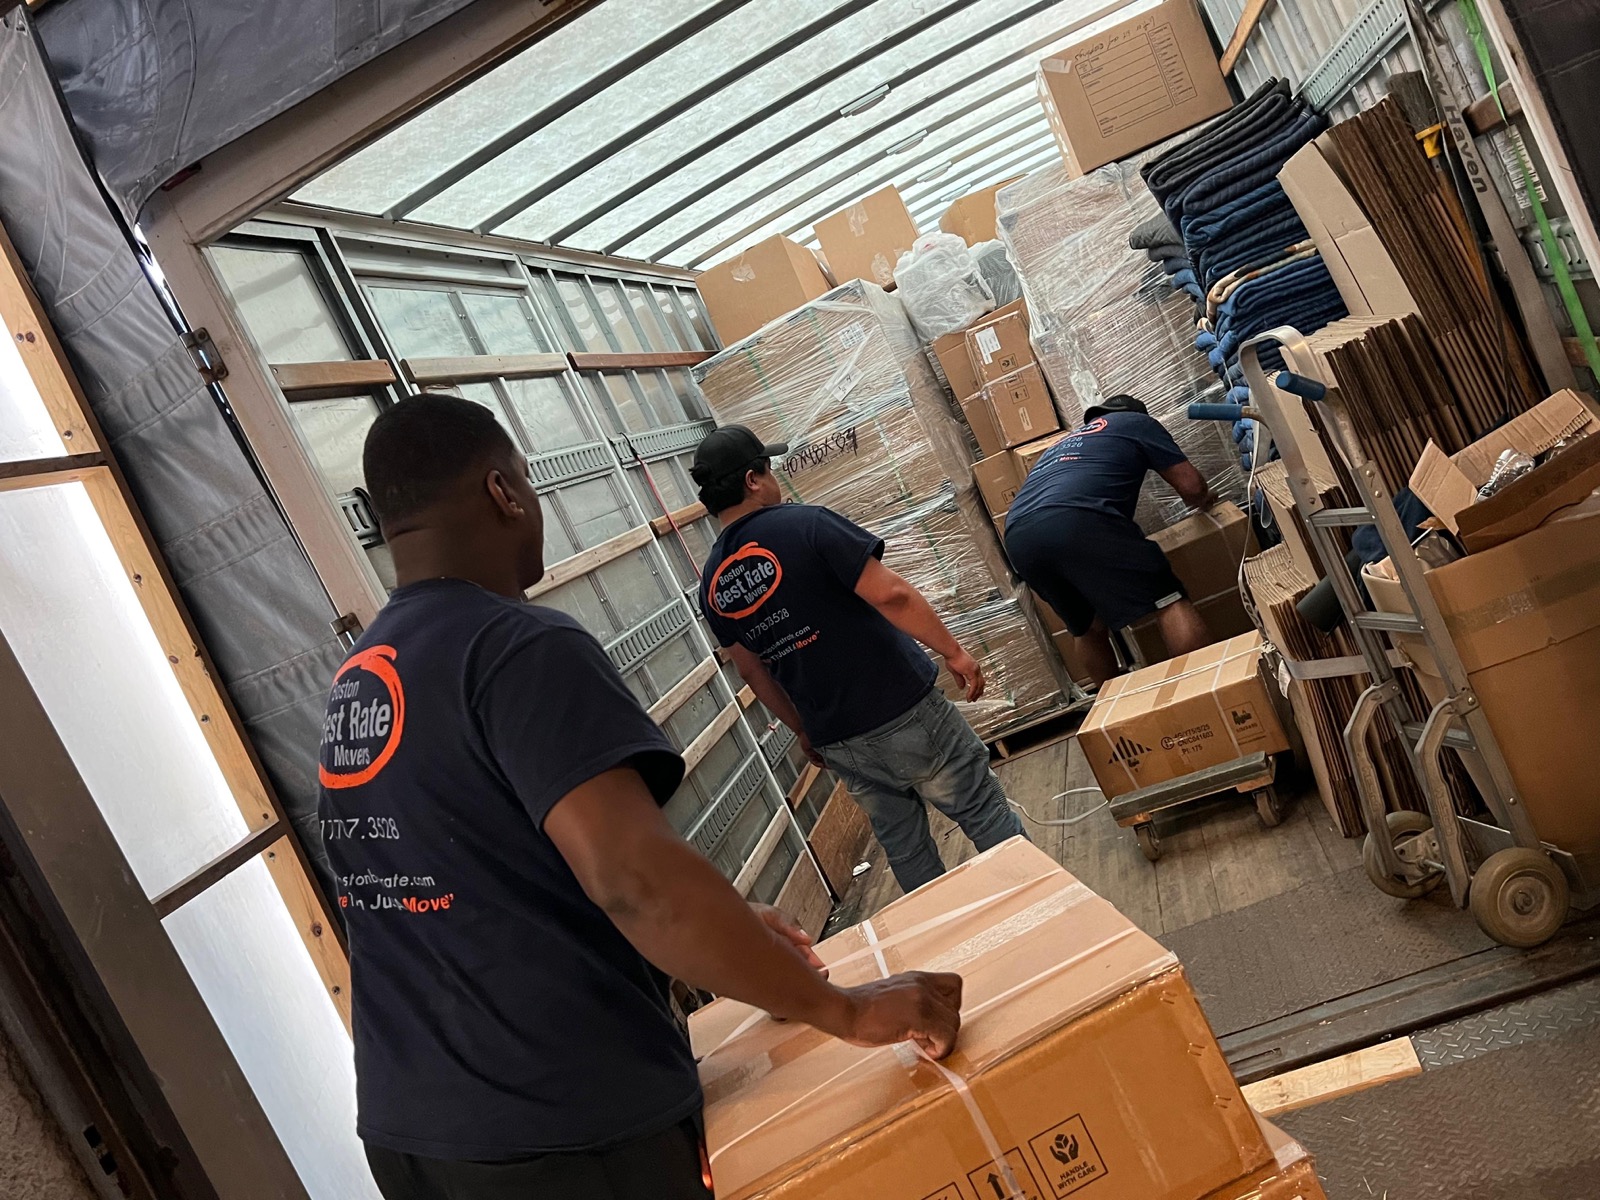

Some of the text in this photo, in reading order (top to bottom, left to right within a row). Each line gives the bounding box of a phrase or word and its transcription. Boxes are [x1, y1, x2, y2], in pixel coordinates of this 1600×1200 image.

[1444, 106, 1488, 193] Haven
[715, 561, 775, 609] Best Rate
[718, 564, 746, 586] Boston
[349, 697, 391, 741] Rate
[1057, 1164, 1097, 1190] WITH CARE
[1059, 1161, 1089, 1181] HANDLE
